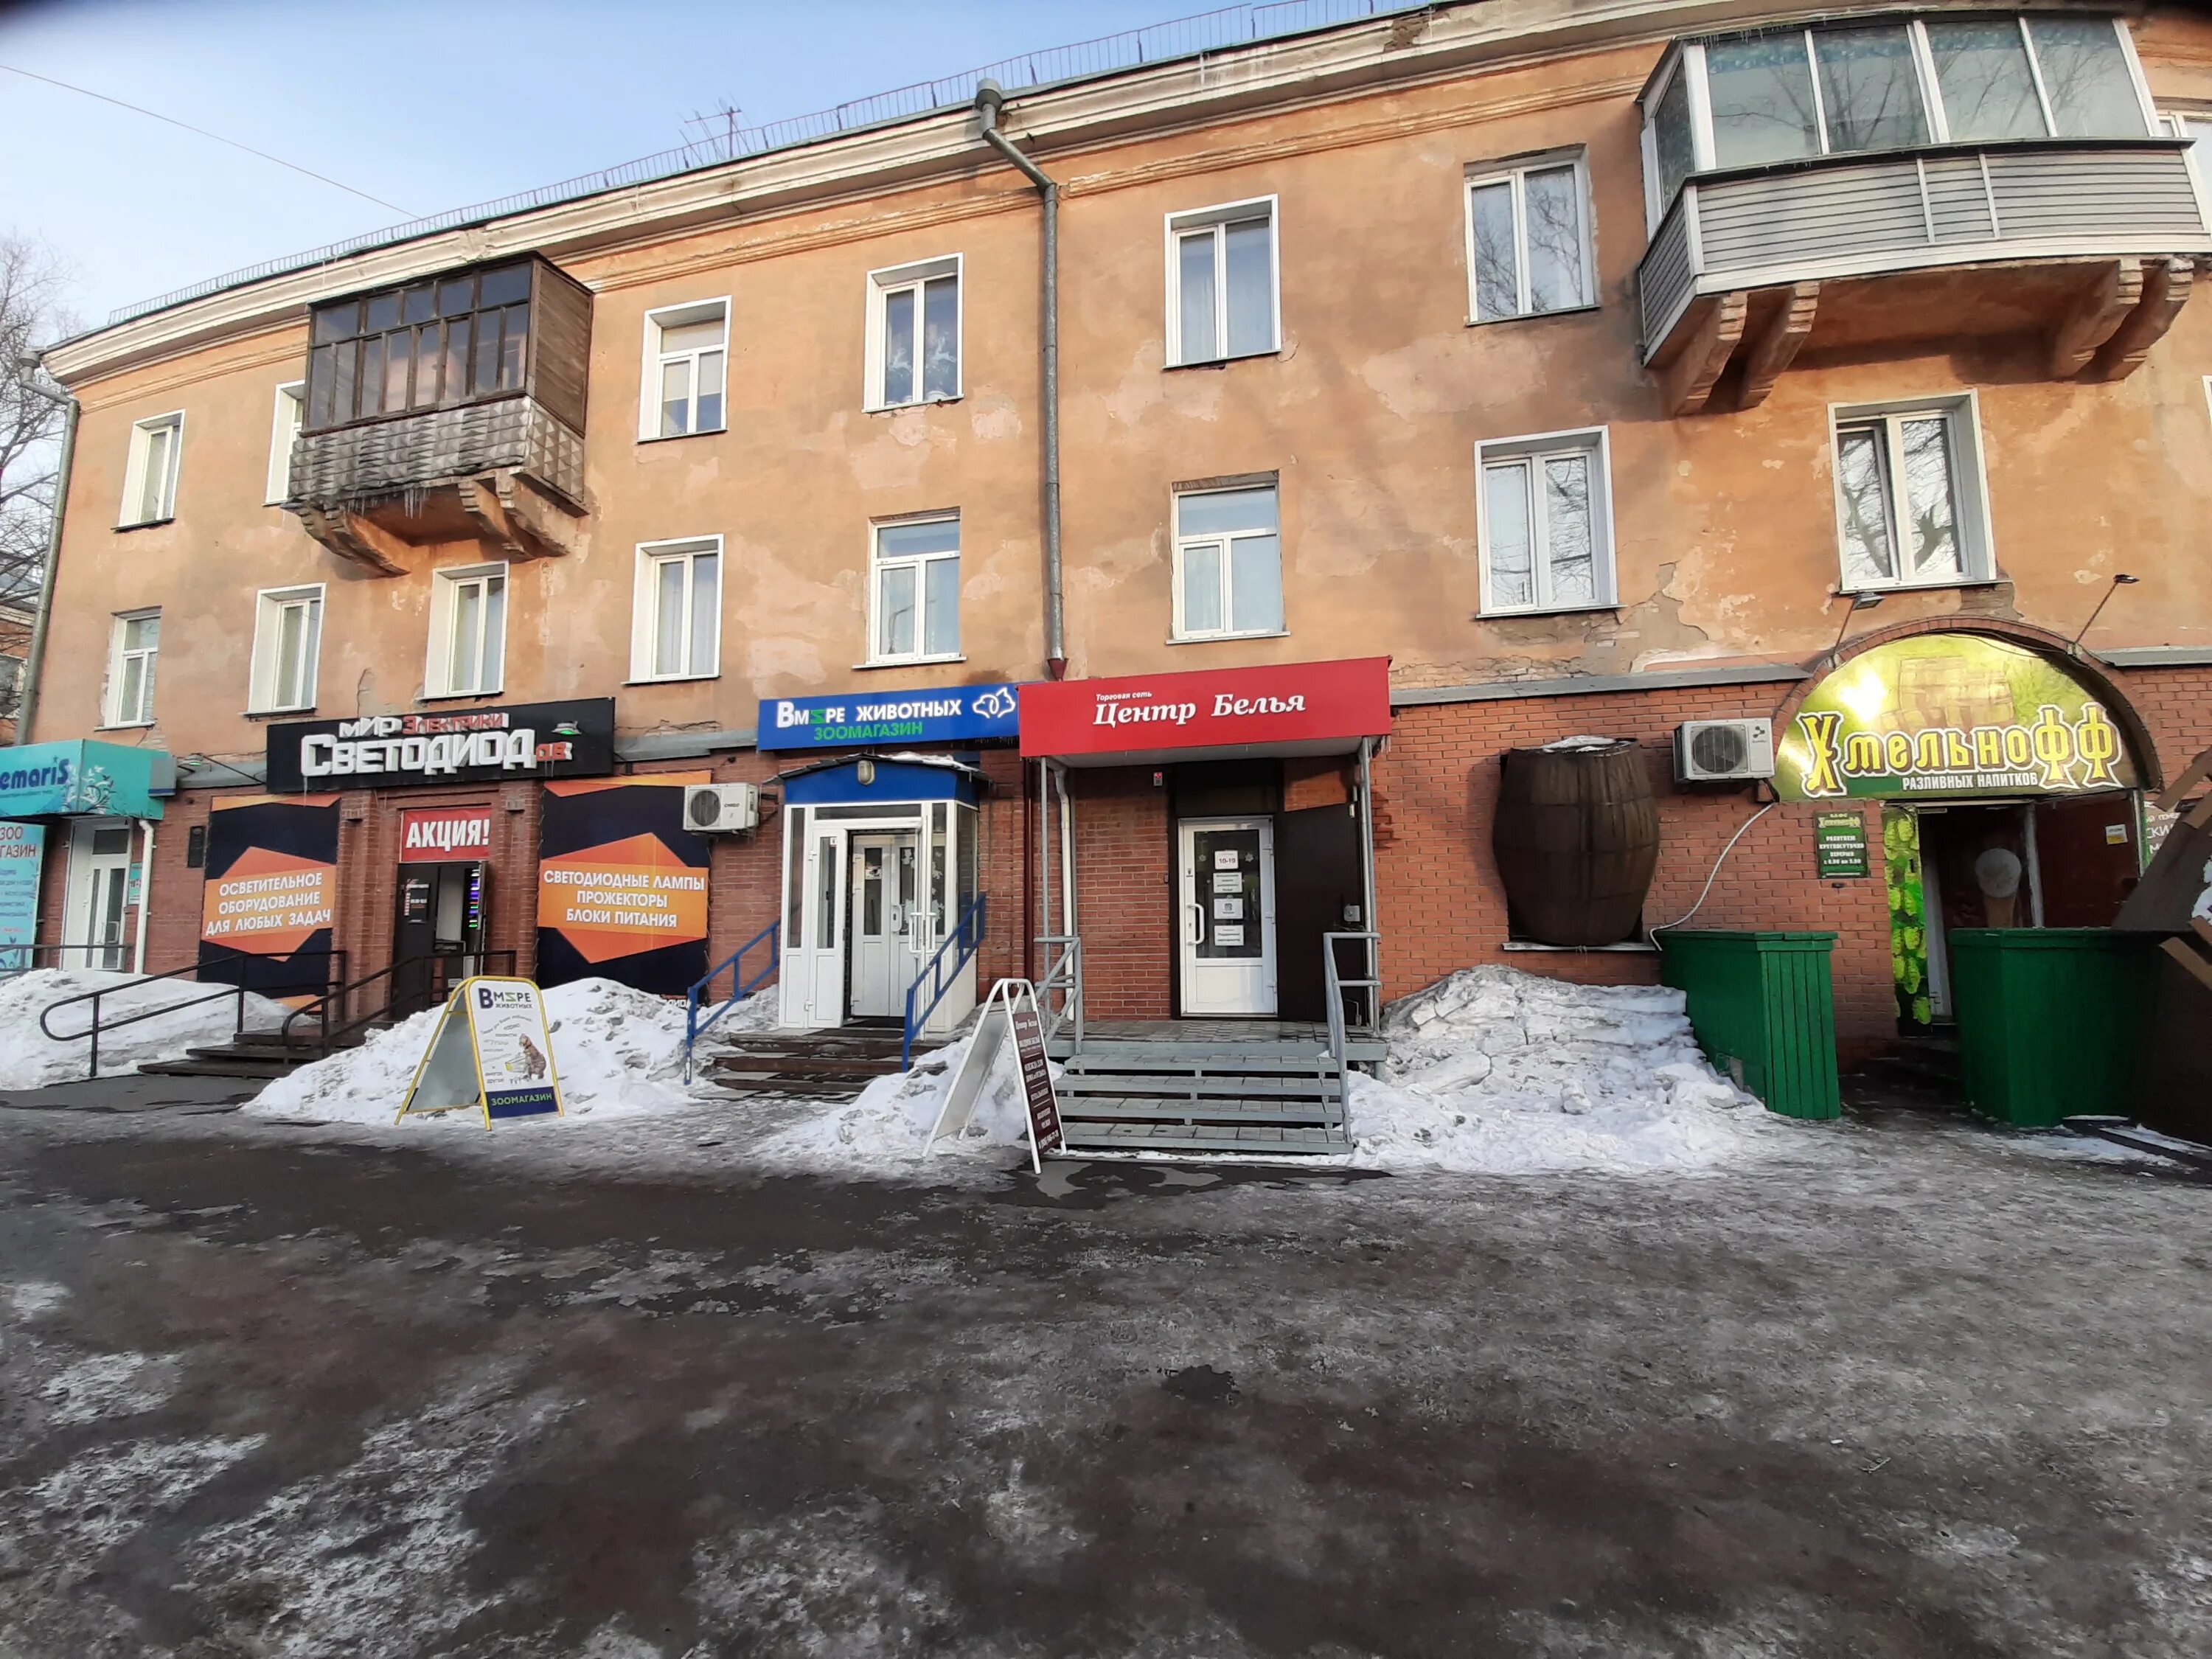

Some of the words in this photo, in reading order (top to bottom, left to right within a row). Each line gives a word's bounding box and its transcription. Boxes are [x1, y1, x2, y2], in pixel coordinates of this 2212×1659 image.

[1096, 693, 1130, 701] Торговая
[1132, 691, 1152, 700] сеть
[855, 700, 961, 722] ЖИВОТНЫХ
[1093, 702, 1196, 728] Центр
[1211, 693, 1306, 717] Белья
[813, 722, 923, 740] ЗООМАГАЗИН
[1902, 775, 1973, 791] РАЗЛИВНЫХ
[1977, 772, 2038, 788] НАПИТКОВ
[406, 818, 490, 852] АКЦИЯ!
[219, 872, 322, 896] ОСВЕТИТЕЛЬНОЕ
[543, 870, 649, 888] СВЕТОДИОДНЫЕ
[653, 876, 705, 890] ЛАМПЫ
[218, 891, 320, 914] ОБОРУДОВАНИЕ
[577, 890, 667, 908] ПРОЖЕКТОРЫ
[206, 920, 229, 936] ДЛЯ
[235, 914, 282, 932] ЛЮБЫХ
[288, 908, 331, 926] ЗАДАЧ
[566, 908, 611, 924] БЛОКИ
[614, 911, 677, 928] ПИТАНИЯ
[491, 1093, 552, 1106] ЗООМАГАЗИН
